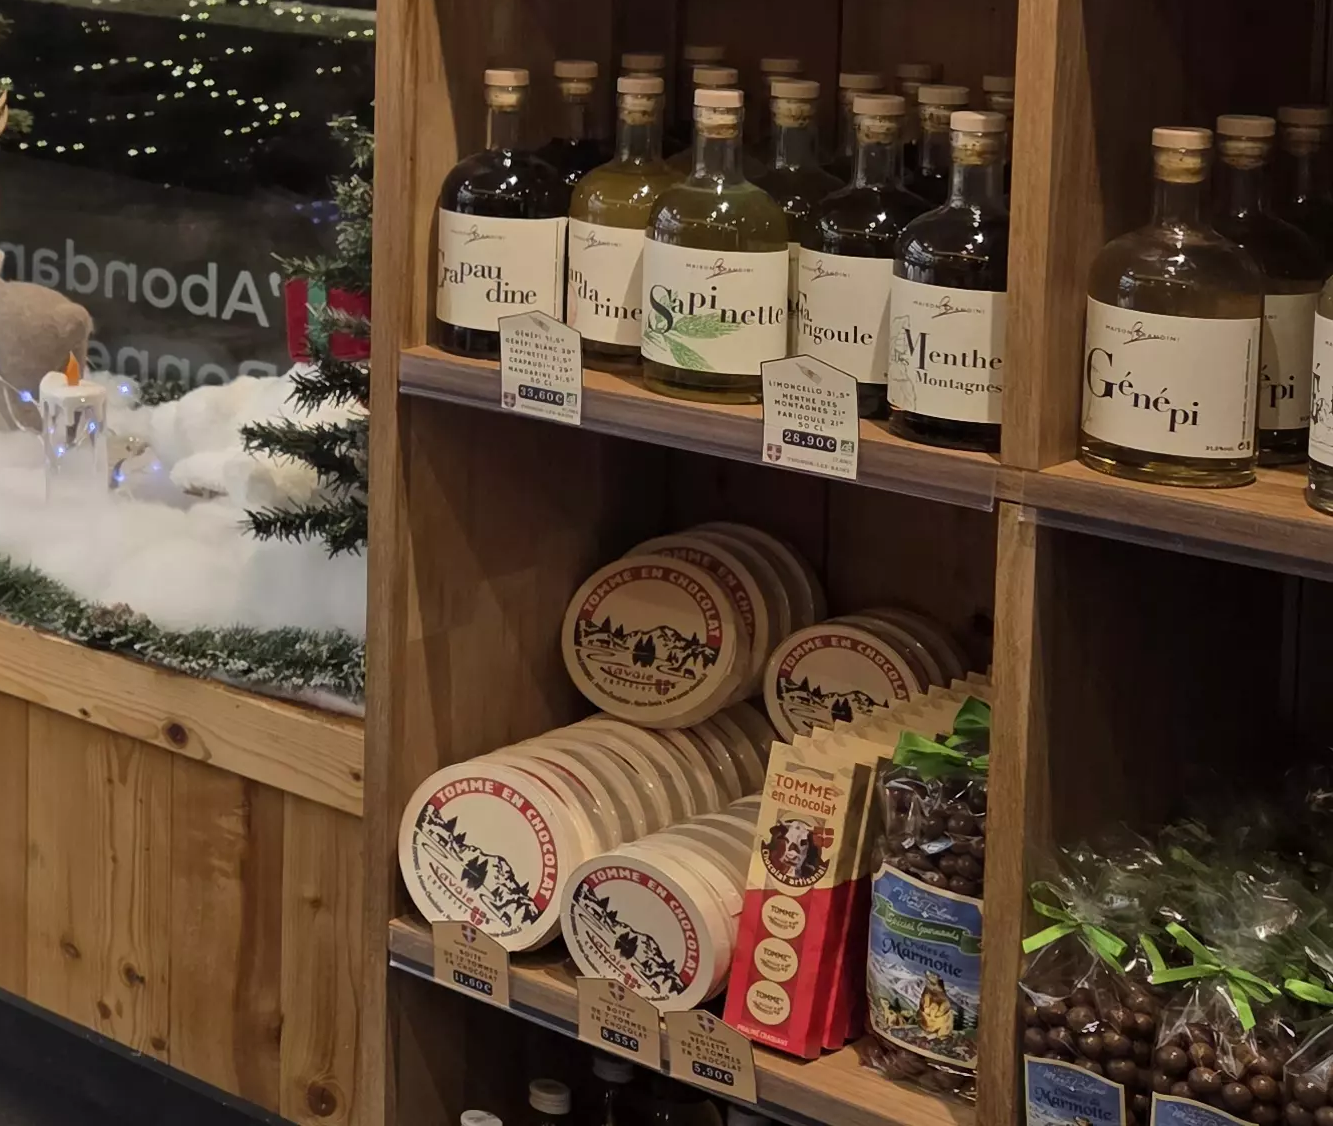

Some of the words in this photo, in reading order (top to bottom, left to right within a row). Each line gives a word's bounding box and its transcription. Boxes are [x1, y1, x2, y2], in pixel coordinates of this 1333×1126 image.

[902, 326, 1003, 371] Menthe
[768, 379, 823, 395] LIMONCELLO
[782, 392, 817, 405] MENTHE
[820, 399, 838, 408] DES
[916, 370, 1003, 396] Montagnes
[1087, 346, 1200, 433] Génépi
[774, 399, 829, 415] MONTAGNES
[777, 410, 826, 425] FARIGOULE
[784, 431, 835, 450] 28,90€
[583, 570, 632, 612] TOMME
[641, 567, 663, 579] EN
[669, 574, 721, 638] CHOCOLAT
[782, 637, 824, 671] TOMME
[830, 636, 852, 648] EN
[857, 643, 906, 701] CHOCOLA
[771, 789, 786, 802] en
[788, 793, 837, 816] chocolat
[774, 772, 835, 802] TOMME
[436, 778, 494, 803] TOMME
[501, 786, 525, 809] EN
[525, 808, 557, 900] CHOCOLAT
[761, 848, 788, 883] Chocolat
[788, 865, 828, 887] artisanal
[589, 867, 641, 884] TOMME
[646, 880, 667, 899] EN
[670, 901, 699, 978] CHOCOLAT
[882, 937, 964, 979] Marmotte
[1034, 1085, 1112, 1121] Marmotte
